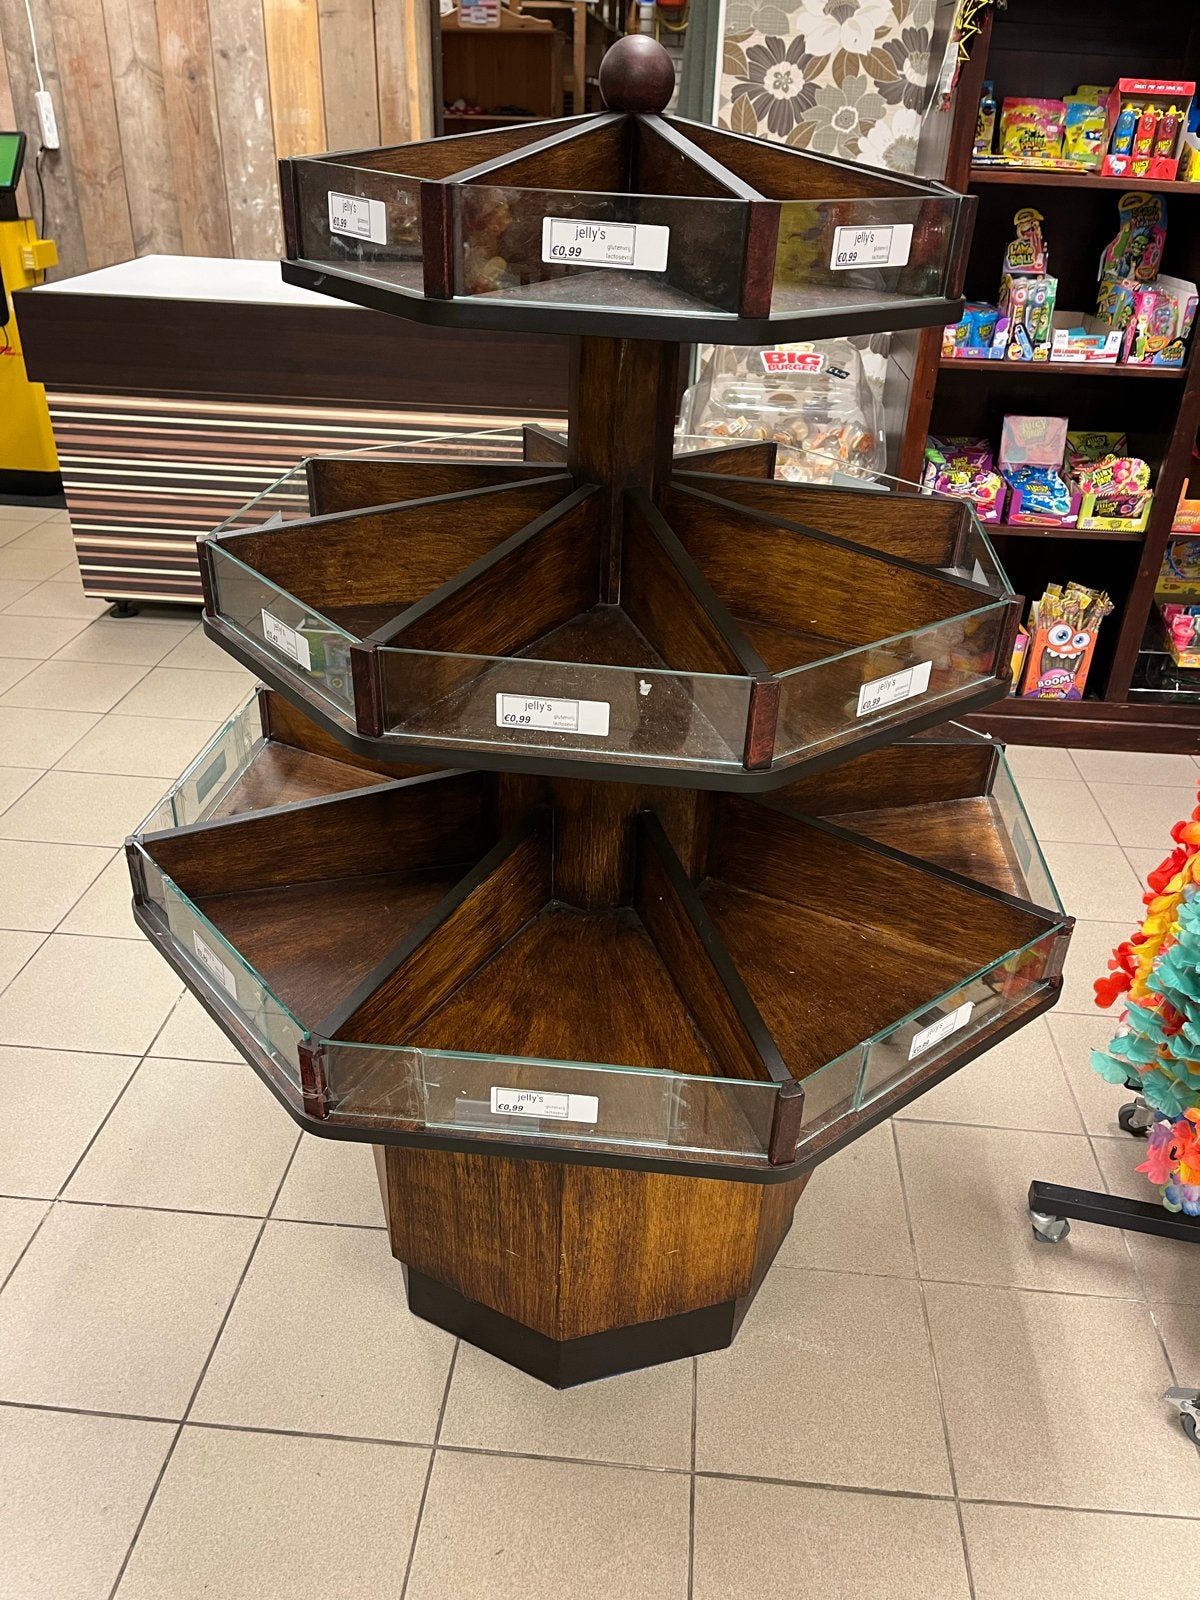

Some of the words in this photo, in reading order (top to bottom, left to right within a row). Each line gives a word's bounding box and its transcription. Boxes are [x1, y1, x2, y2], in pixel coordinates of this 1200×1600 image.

[575, 226, 606, 242] jelly's
[854, 231, 875, 246] jelly's
[552, 245, 582, 258] €0,99
[837, 251, 858, 263] €0,99
[763, 351, 822, 366] BIG
[767, 363, 818, 372] BURGER
[1021, 418, 1047, 432] JUICY
[877, 678, 896, 695] jelly's
[1037, 673, 1074, 688] BOOM!
[524, 700, 552, 712] jelly's
[504, 714, 531, 724] €0,99
[517, 1093, 544, 1104] jelly's
[498, 1103, 524, 1112] €0,99
